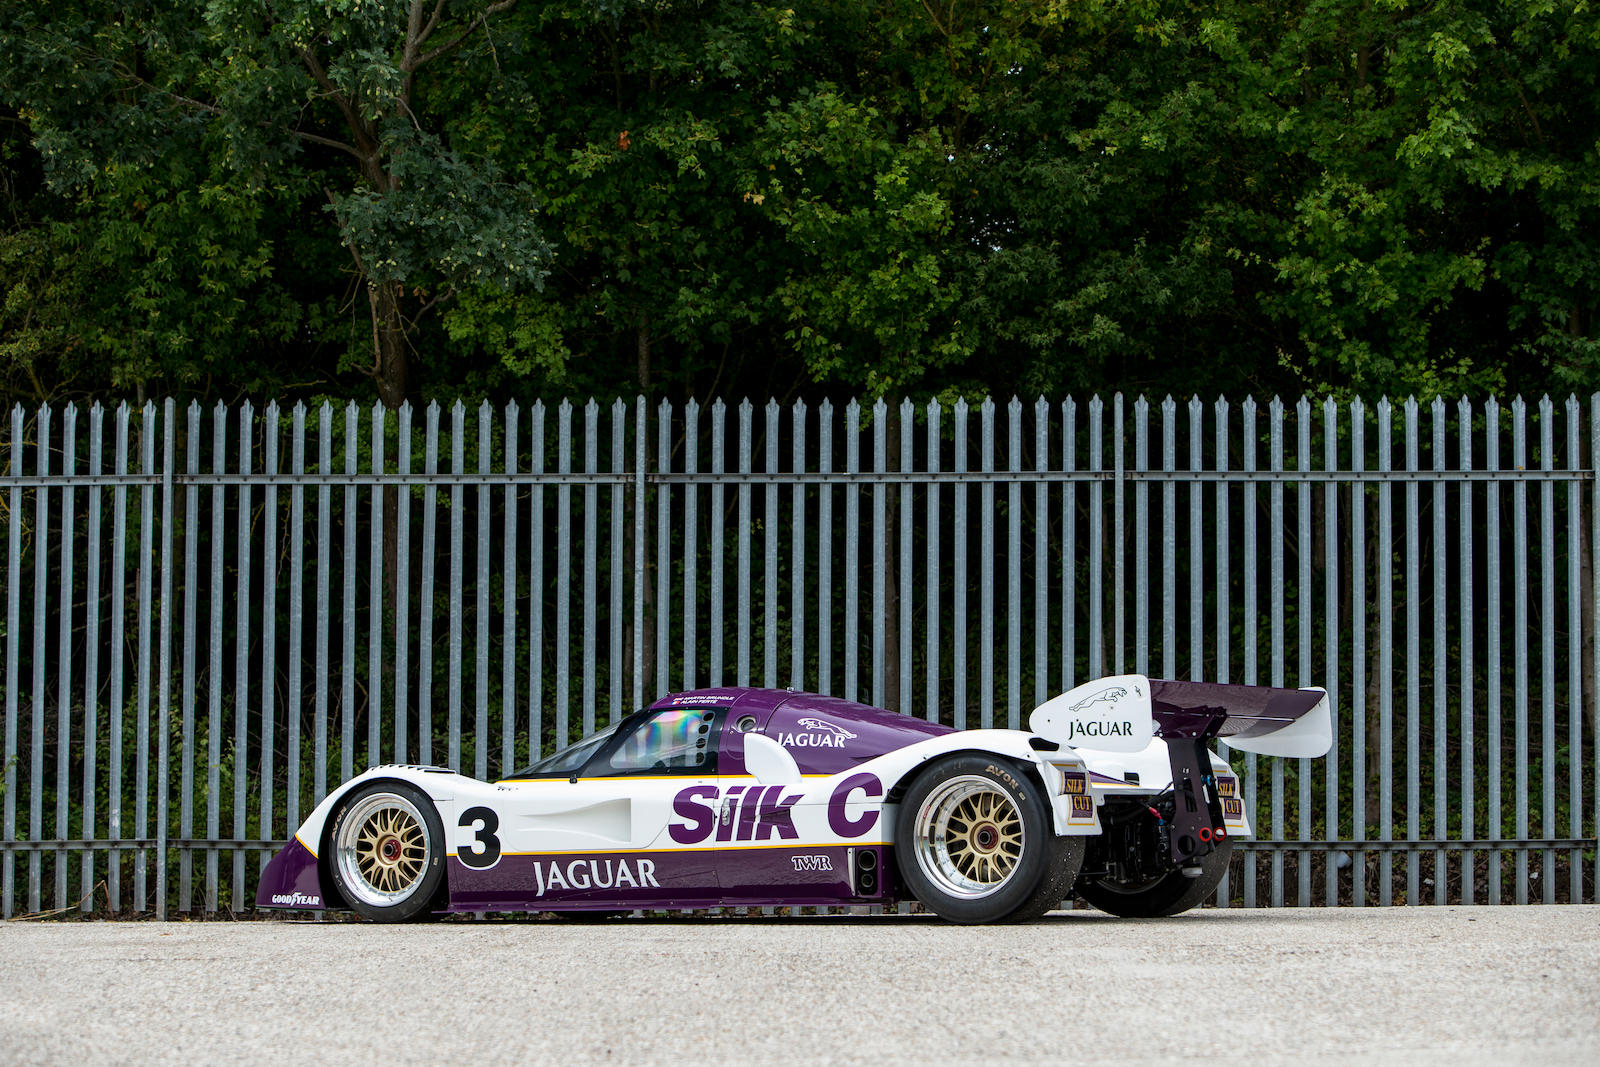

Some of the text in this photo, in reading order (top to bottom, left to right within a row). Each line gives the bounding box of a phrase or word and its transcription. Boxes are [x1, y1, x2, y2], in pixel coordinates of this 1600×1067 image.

[1069, 721, 1132, 740] JAGUAR
[778, 732, 845, 748] JAGUAR
[985, 765, 1019, 790] AVON
[1065, 779, 1085, 793] SILK
[1218, 782, 1234, 796] SILK
[668, 772, 883, 844] Silk C
[1074, 796, 1091, 810] CUT
[1226, 800, 1240, 814] CUT
[457, 806, 501, 868] 3
[791, 855, 833, 871] TWR
[533, 859, 661, 897] JAGUAR
[271, 892, 320, 906] GOODYEAR
